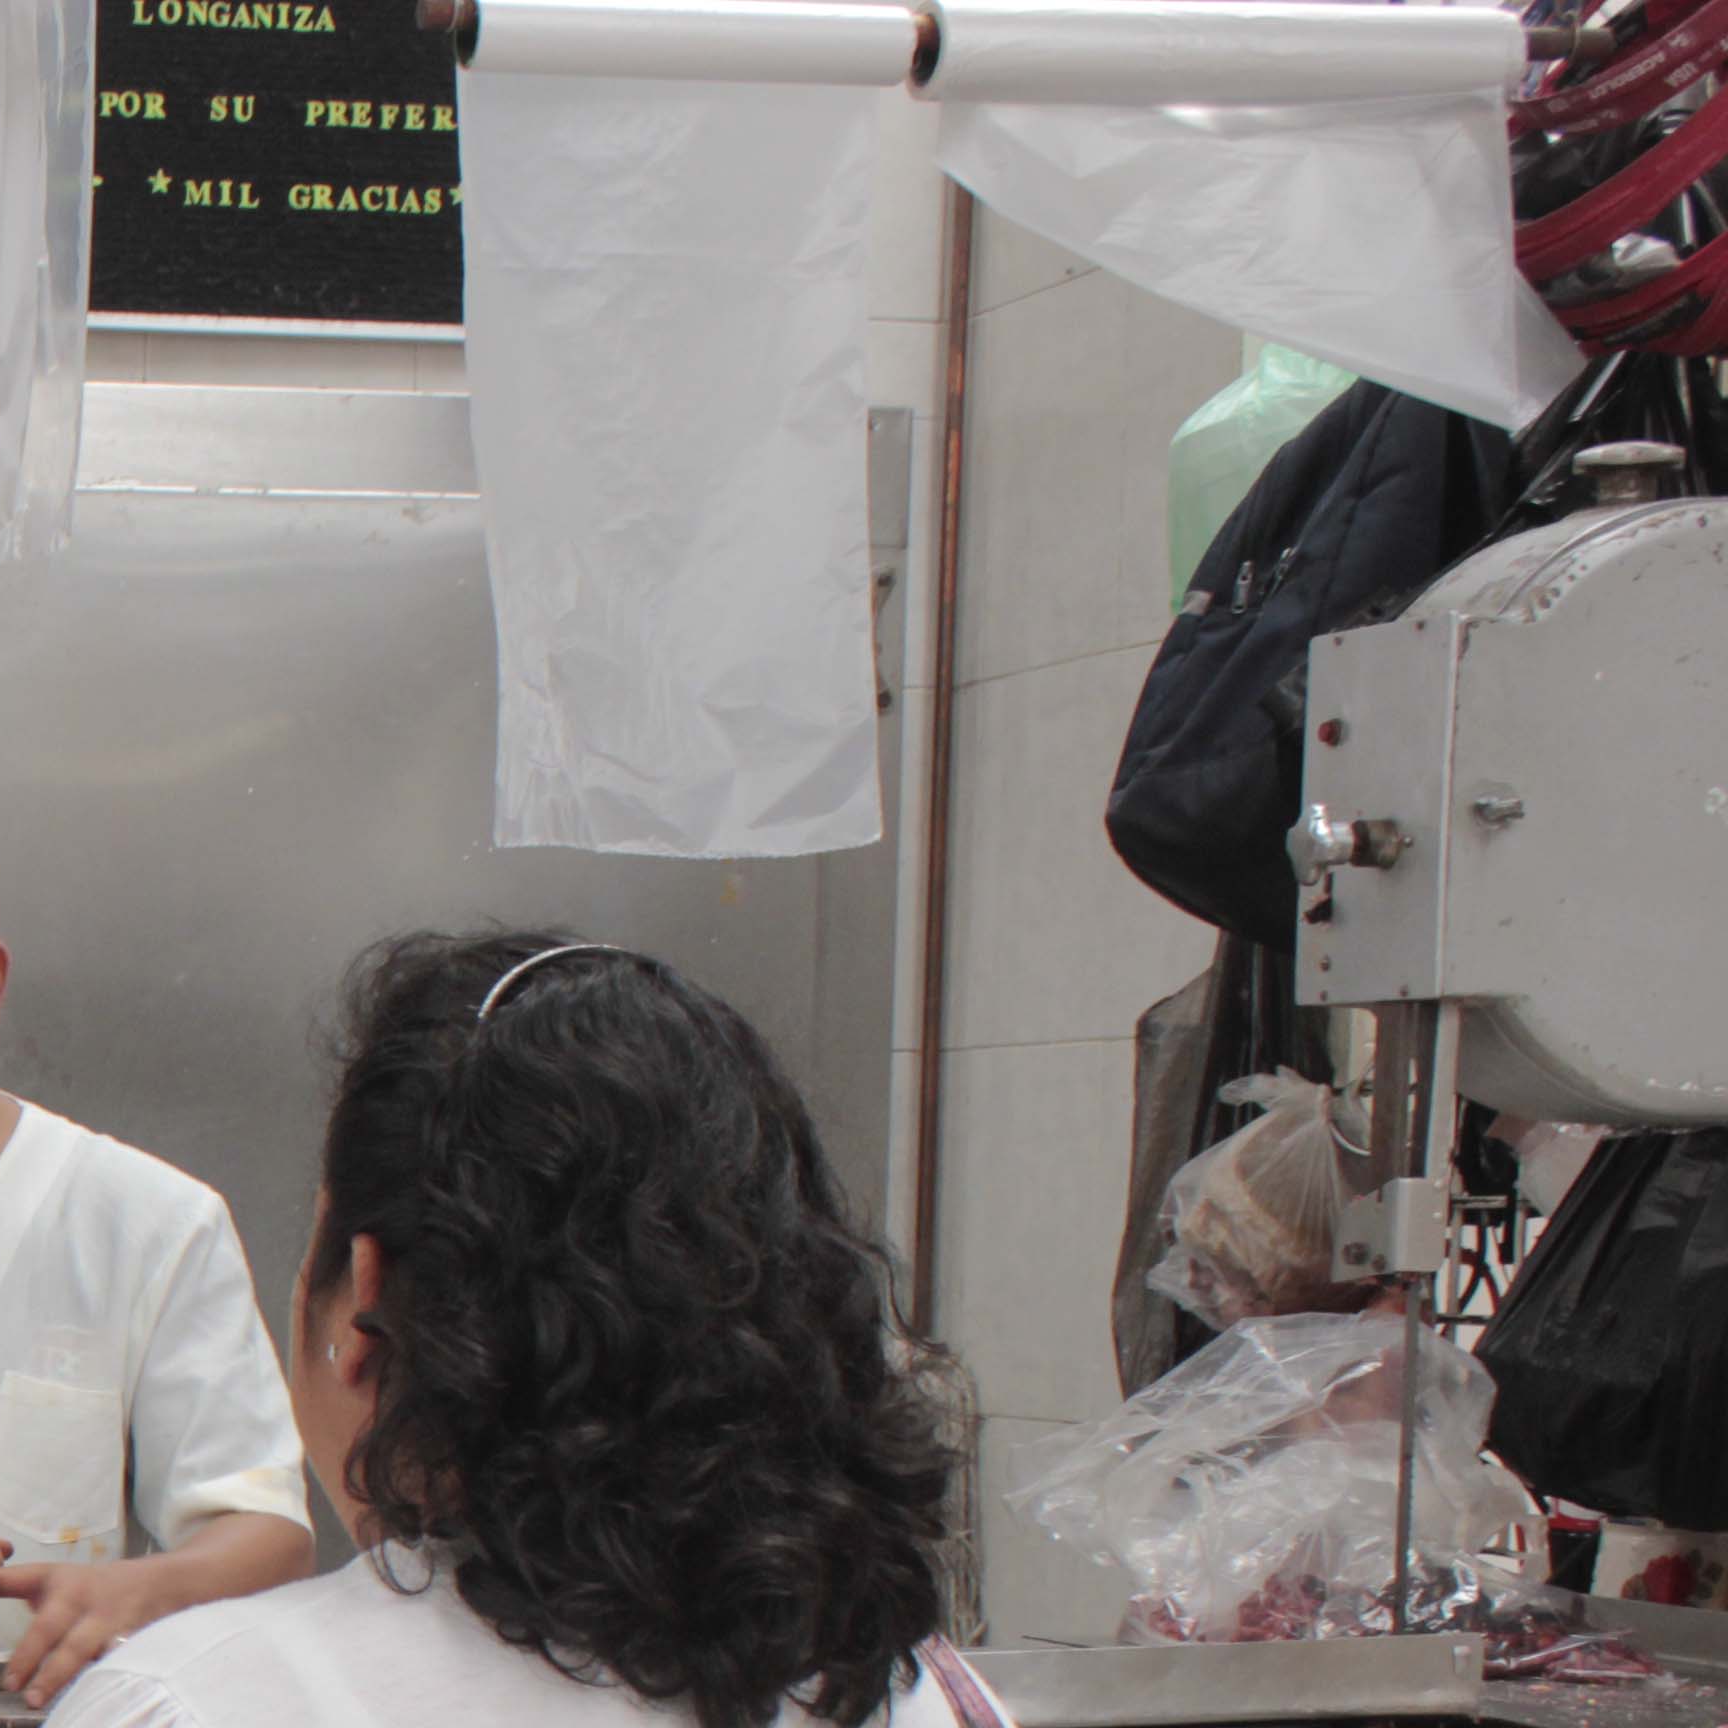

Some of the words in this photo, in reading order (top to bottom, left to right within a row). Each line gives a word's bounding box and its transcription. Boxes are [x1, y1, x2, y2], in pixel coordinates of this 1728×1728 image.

[133, 0, 336, 32] LONGANIZA
[99, 91, 167, 120] POR
[210, 96, 255, 122] SU
[184, 178, 260, 208] MIL
[288, 184, 442, 213] GRACIAS
